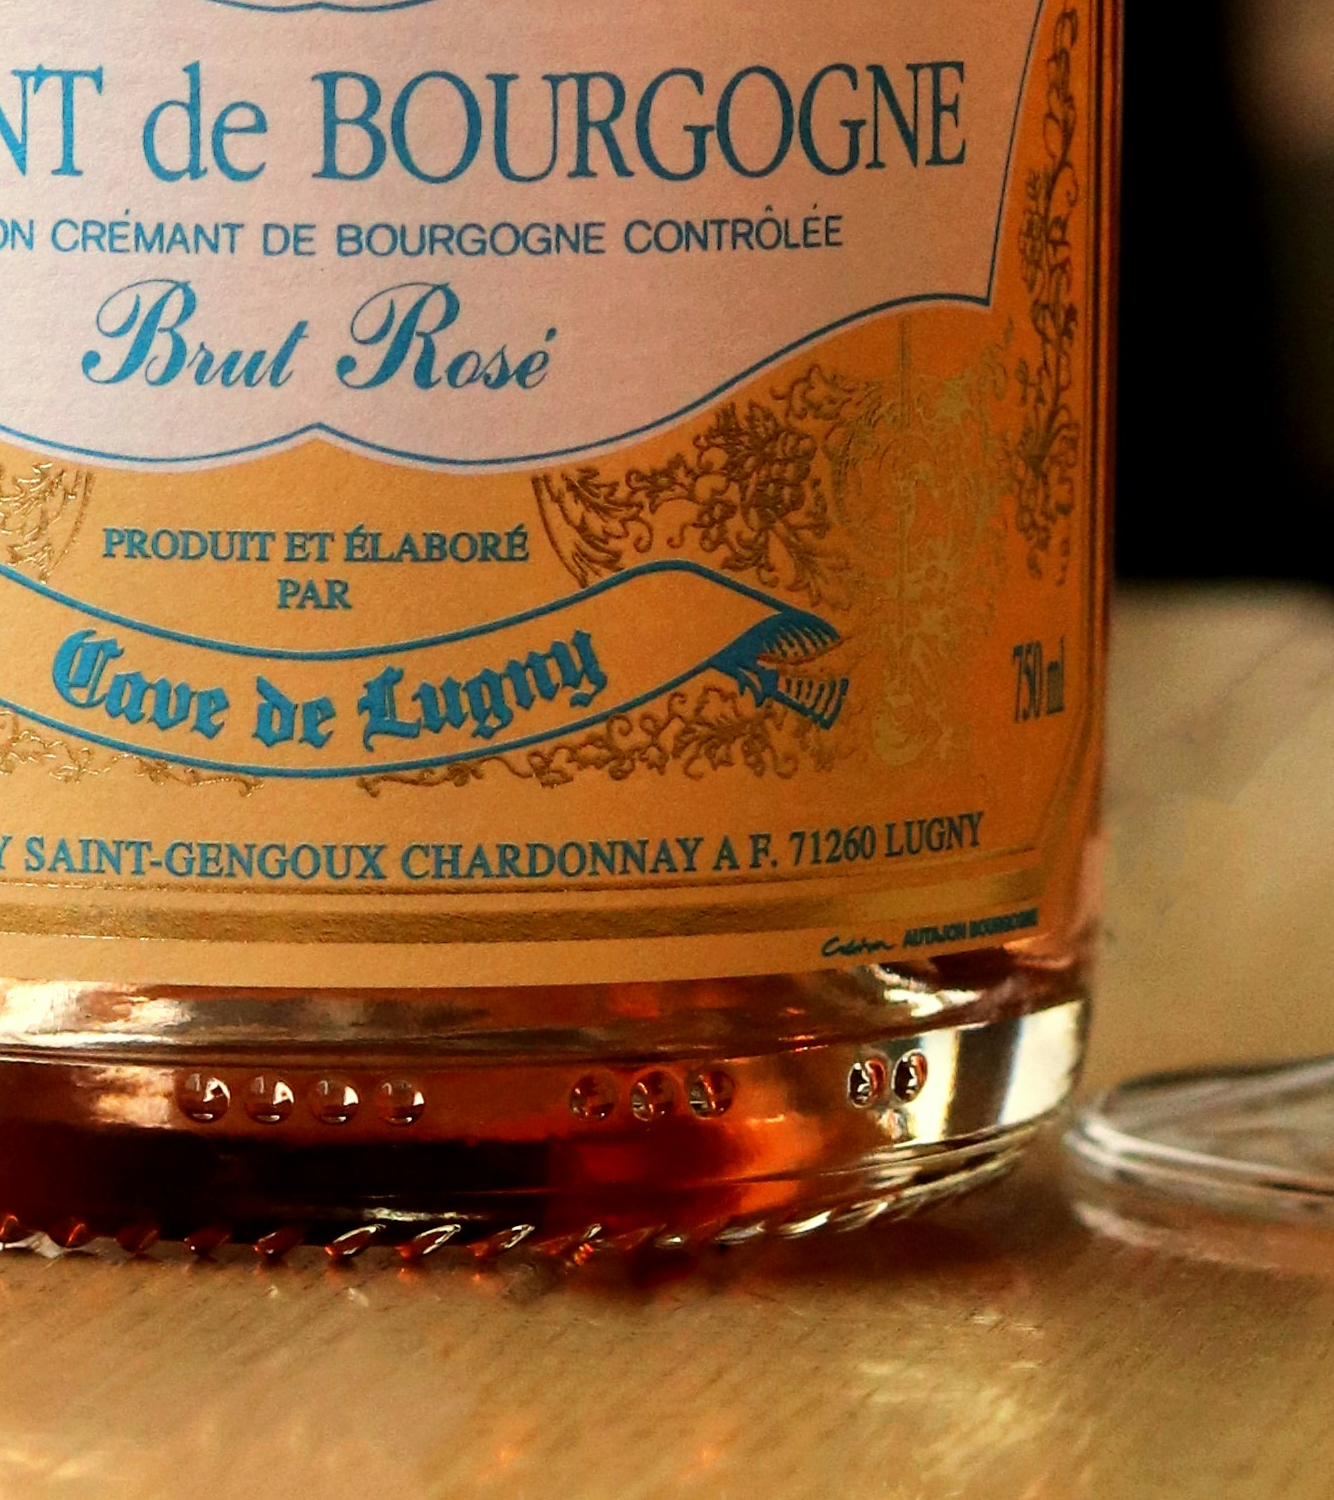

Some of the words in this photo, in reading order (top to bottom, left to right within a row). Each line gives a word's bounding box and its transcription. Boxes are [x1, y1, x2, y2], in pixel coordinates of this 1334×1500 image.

[141, 60, 269, 183] de
[311, 60, 967, 185] BOURGOGNE
[49, 208, 246, 257] CRÉMANT
[262, 221, 317, 257] DE
[335, 220, 607, 259] BOURGOGNE
[622, 203, 844, 255] CONTRÔLÉE
[80, 278, 309, 389] Brut
[334, 281, 558, 392] Rosé
[102, 526, 276, 563] PRODUIT
[284, 530, 336, 564] ET
[343, 523, 531, 565] ÉLABORÉ
[276, 578, 354, 611] PAR
[51, 628, 229, 736] Cave
[251, 675, 337, 750] de
[357, 629, 609, 752] Lugny
[1012, 640, 1043, 724] 750
[23, 834, 388, 881] SAINT-GENGOUX
[399, 835, 705, 881] CHARDONNAY
[711, 834, 741, 872] A
[748, 832, 779, 870] F.
[788, 824, 878, 868] 71260
[883, 811, 985, 860] LUGNY
